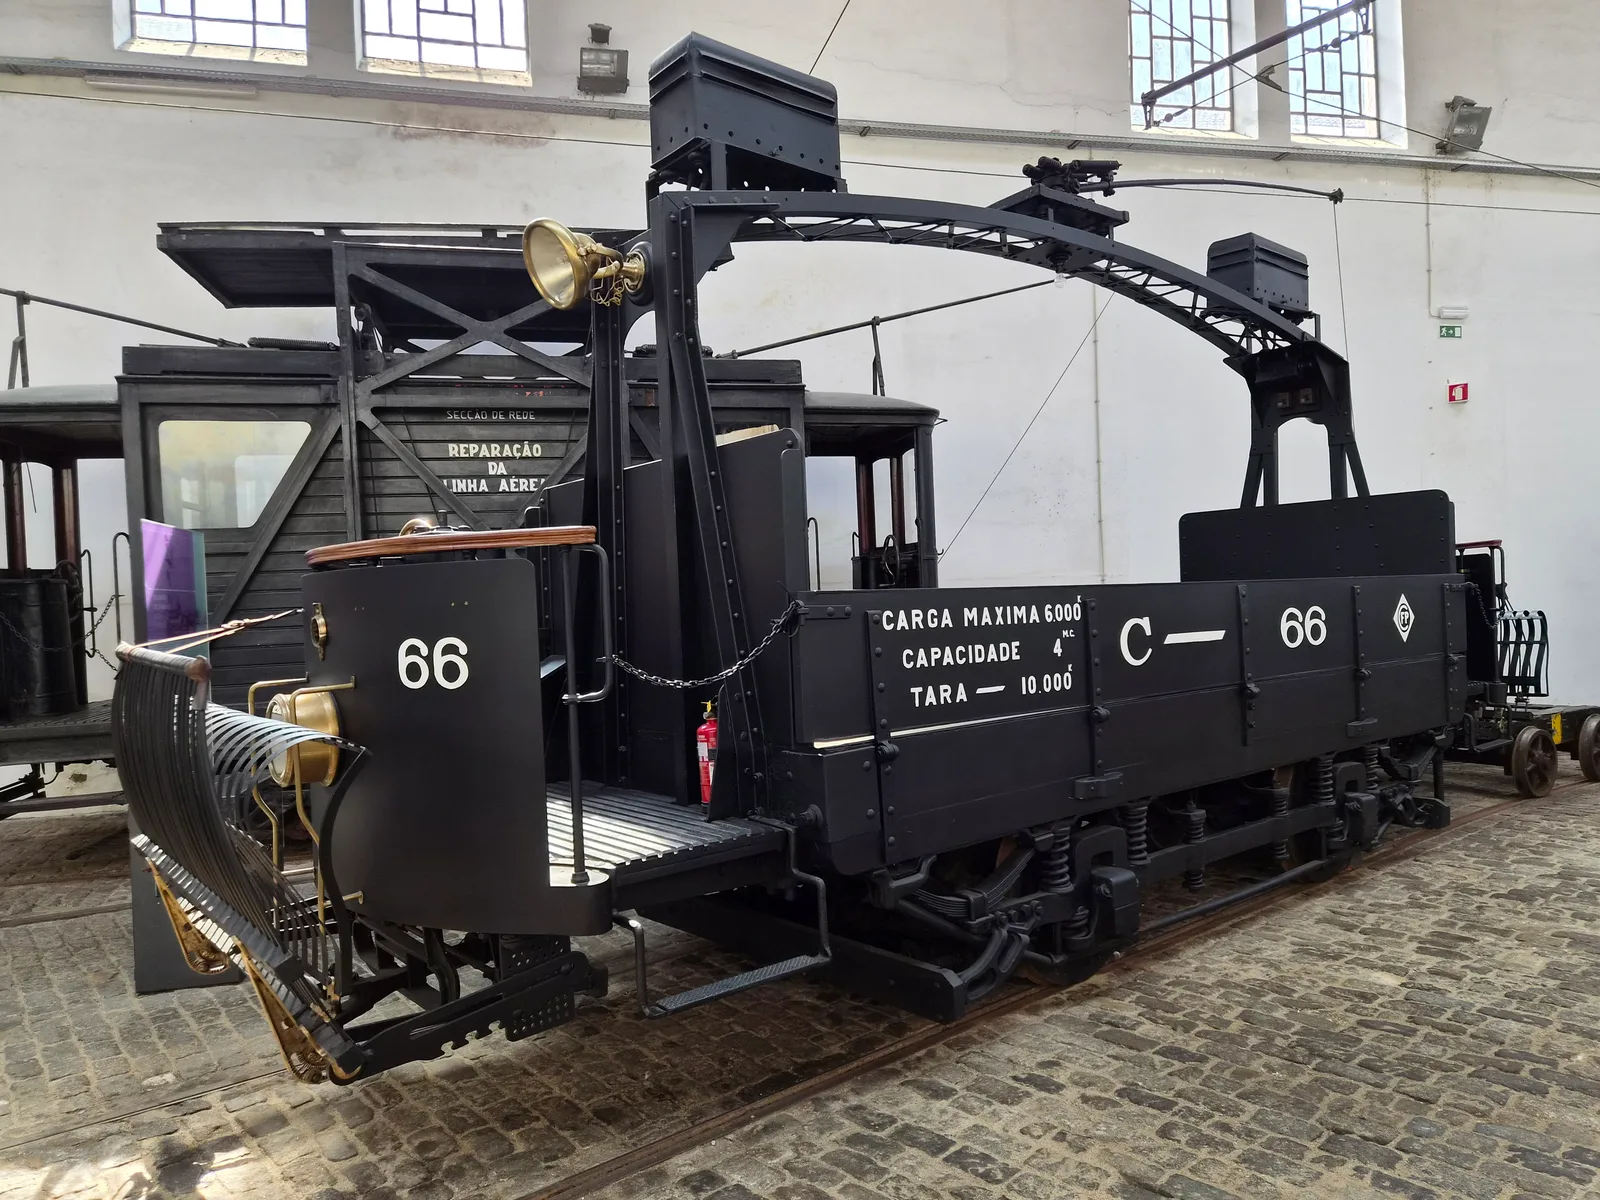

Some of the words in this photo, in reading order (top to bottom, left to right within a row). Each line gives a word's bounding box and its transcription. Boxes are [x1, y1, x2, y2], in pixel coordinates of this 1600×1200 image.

[491, 410, 506, 420] DE
[508, 410, 536, 420] REDE
[448, 441, 542, 459] REPARAÇÃO
[488, 461, 508, 475] DA
[881, 608, 953, 631] CARGA
[963, 604, 1040, 627] MAXIMA
[1280, 605, 1328, 649] 66
[902, 640, 1021, 669] CAPACIDADE
[1053, 638, 1063, 657] 4
[1119, 616, 1153, 667] C
[397, 636, 470, 690] 66
[910, 682, 968, 708] TARA
